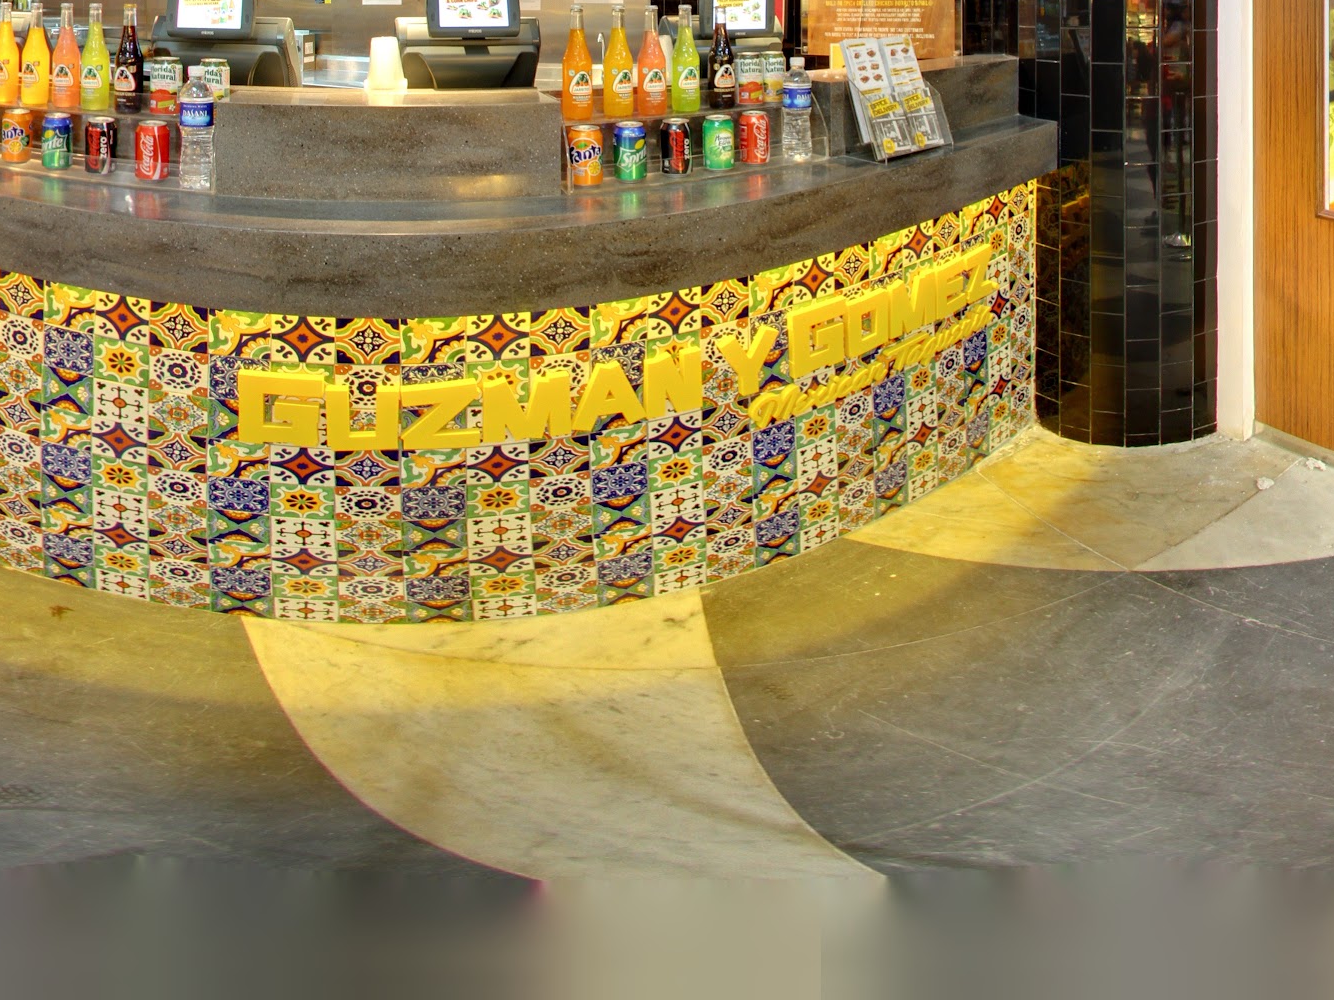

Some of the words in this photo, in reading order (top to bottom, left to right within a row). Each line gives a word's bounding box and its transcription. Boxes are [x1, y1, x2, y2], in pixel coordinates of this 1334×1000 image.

[204, 68, 223, 78] rida's
[204, 76, 222, 85] tural
[869, 100, 889, 109] OFFICE
[873, 103, 898, 116] DELIVERY
[907, 99, 929, 112] DELIVERY
[182, 109, 209, 118] DASANI
[2, 127, 24, 140] anta
[754, 119, 767, 159] Coca-Cola
[42, 136, 64, 151] rite
[139, 131, 155, 176] Coca-Cola
[569, 145, 601, 164] Fanta
[621, 148, 647, 167] Sprit
[238, 347, 702, 450] GUZMAN
[716, 324, 779, 397] Y
[787, 244, 999, 380] GOMEZ
[748, 361, 887, 429] Mexican
[883, 304, 994, 372] Taqueria
